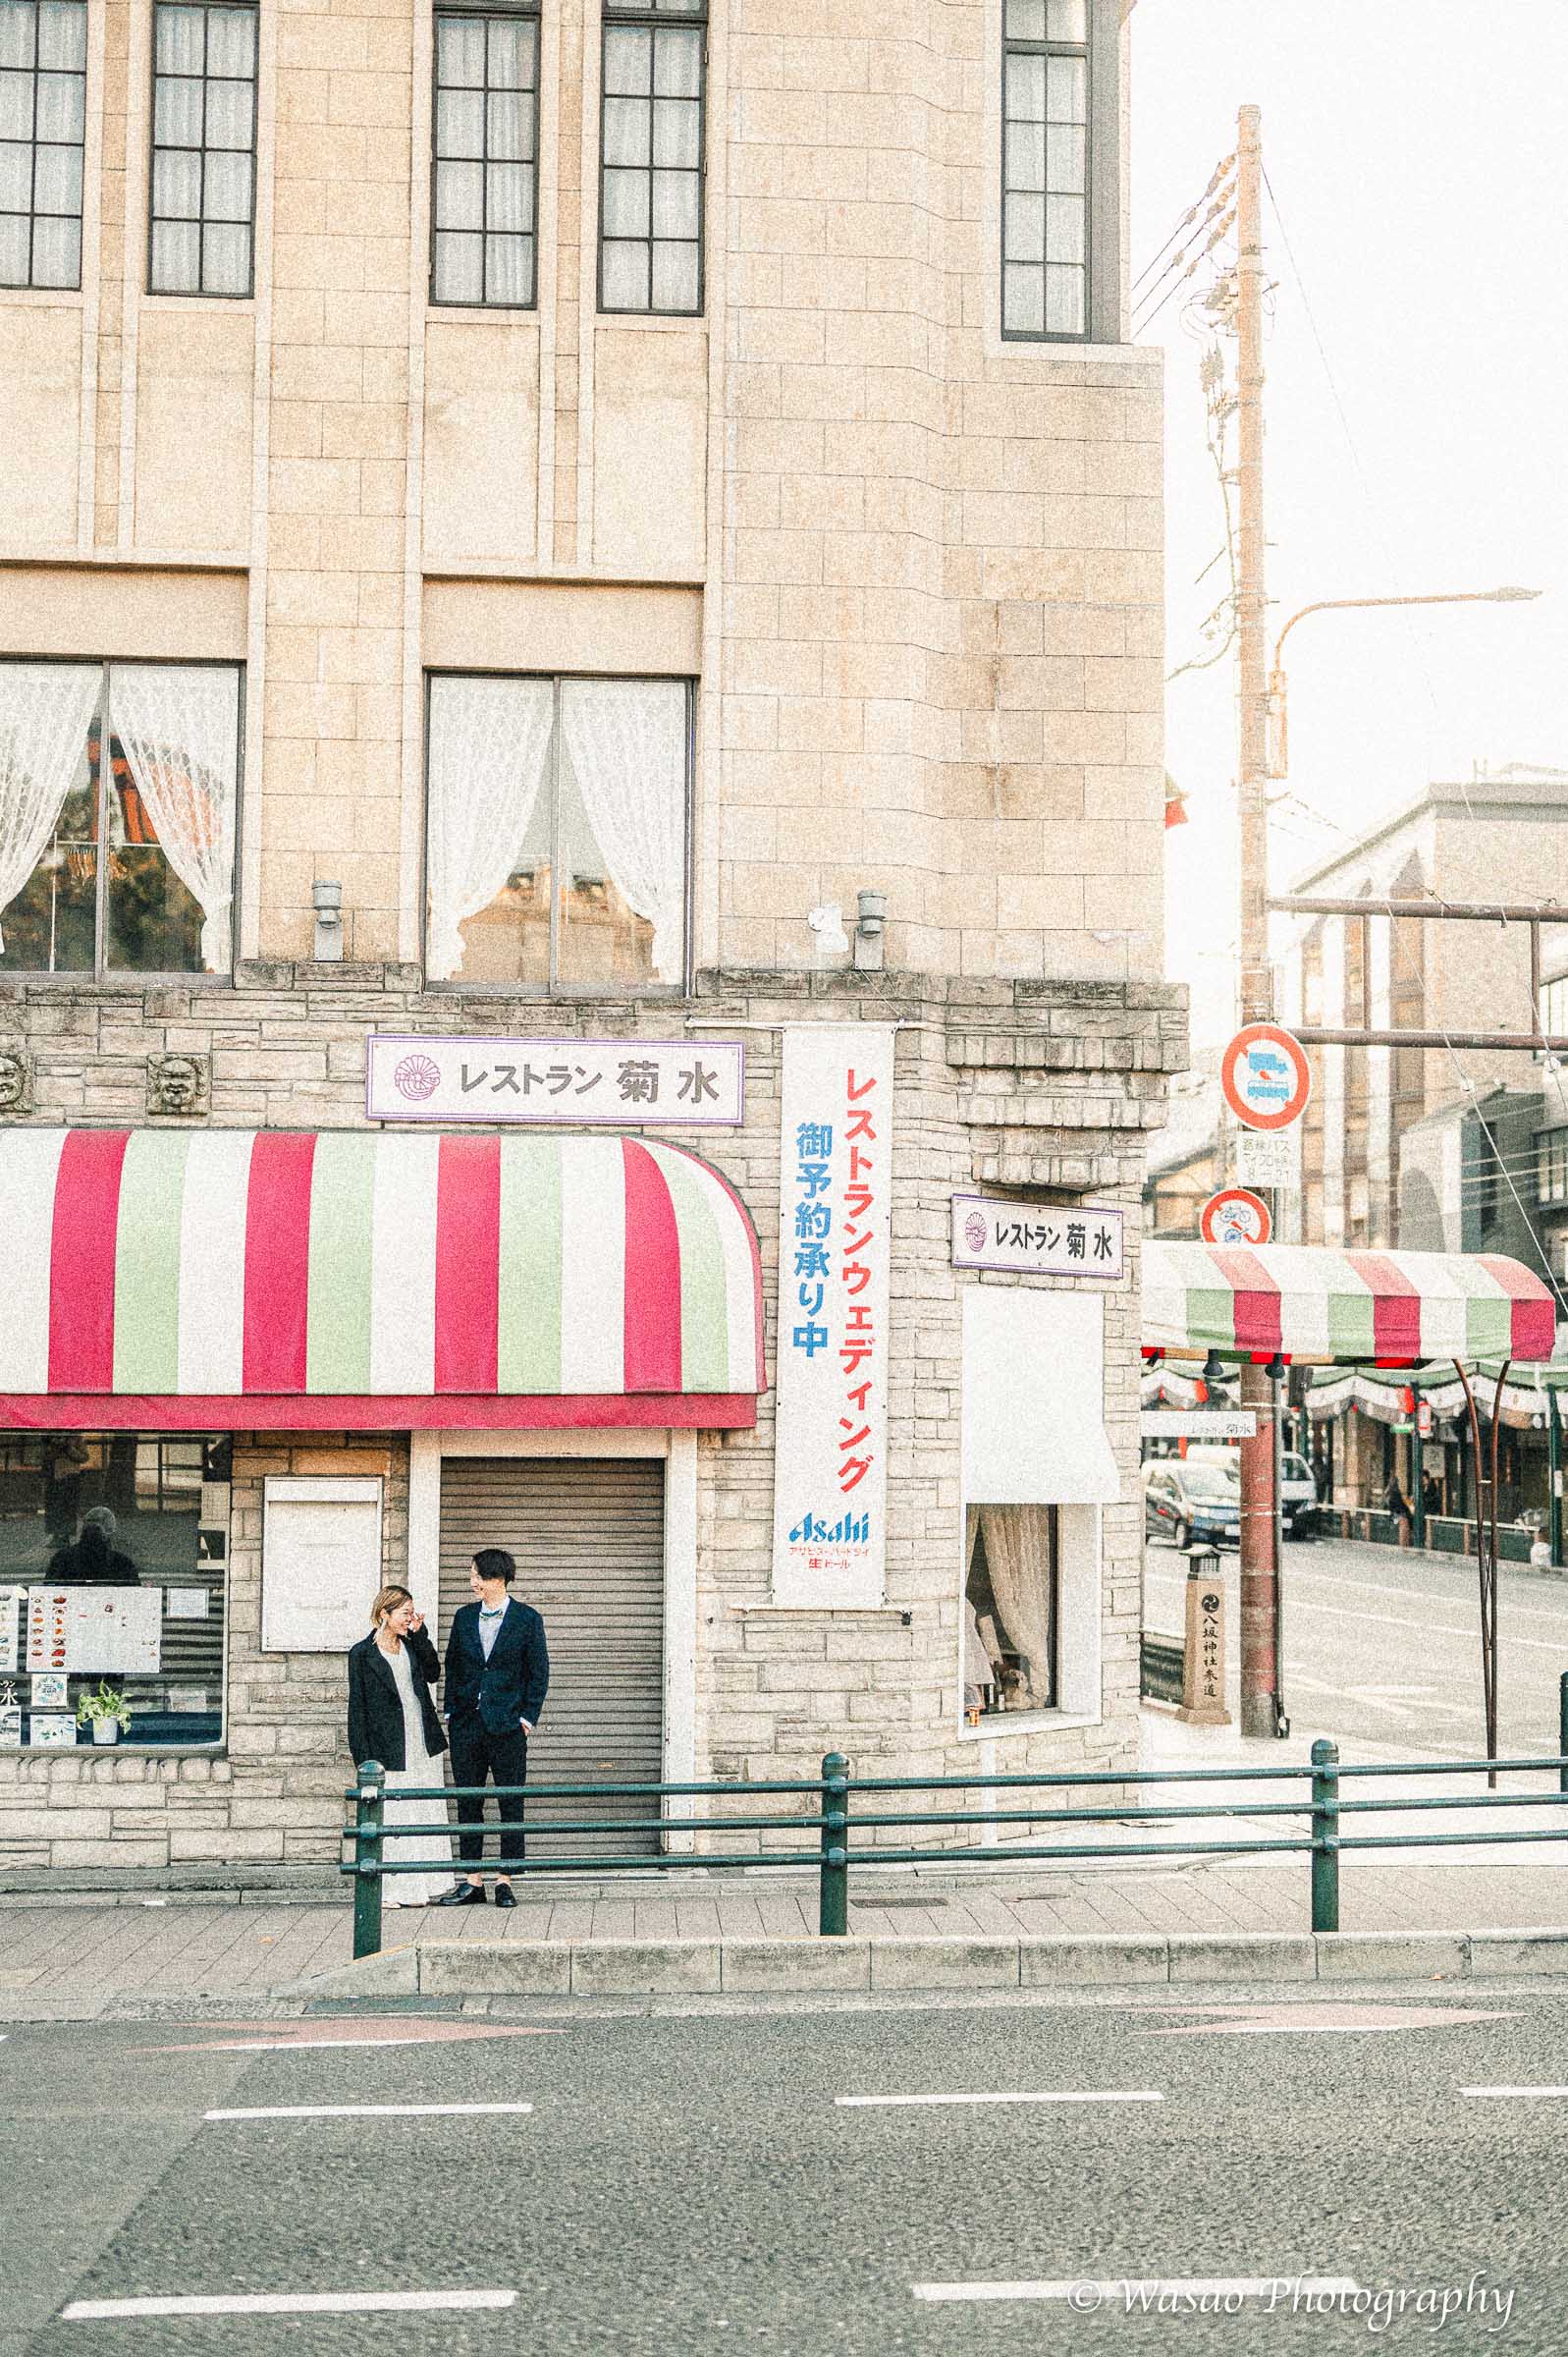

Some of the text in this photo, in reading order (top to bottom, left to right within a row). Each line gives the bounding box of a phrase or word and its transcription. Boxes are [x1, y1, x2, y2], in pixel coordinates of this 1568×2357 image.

[461, 1064, 603, 1096] レストラン
[792, 1123, 833, 1358] 御予約承り中
[996, 1222, 1061, 1251] レストラン
[838, 1069, 877, 1493] レストランウェディング
[788, 1511, 869, 1543] Asahi
